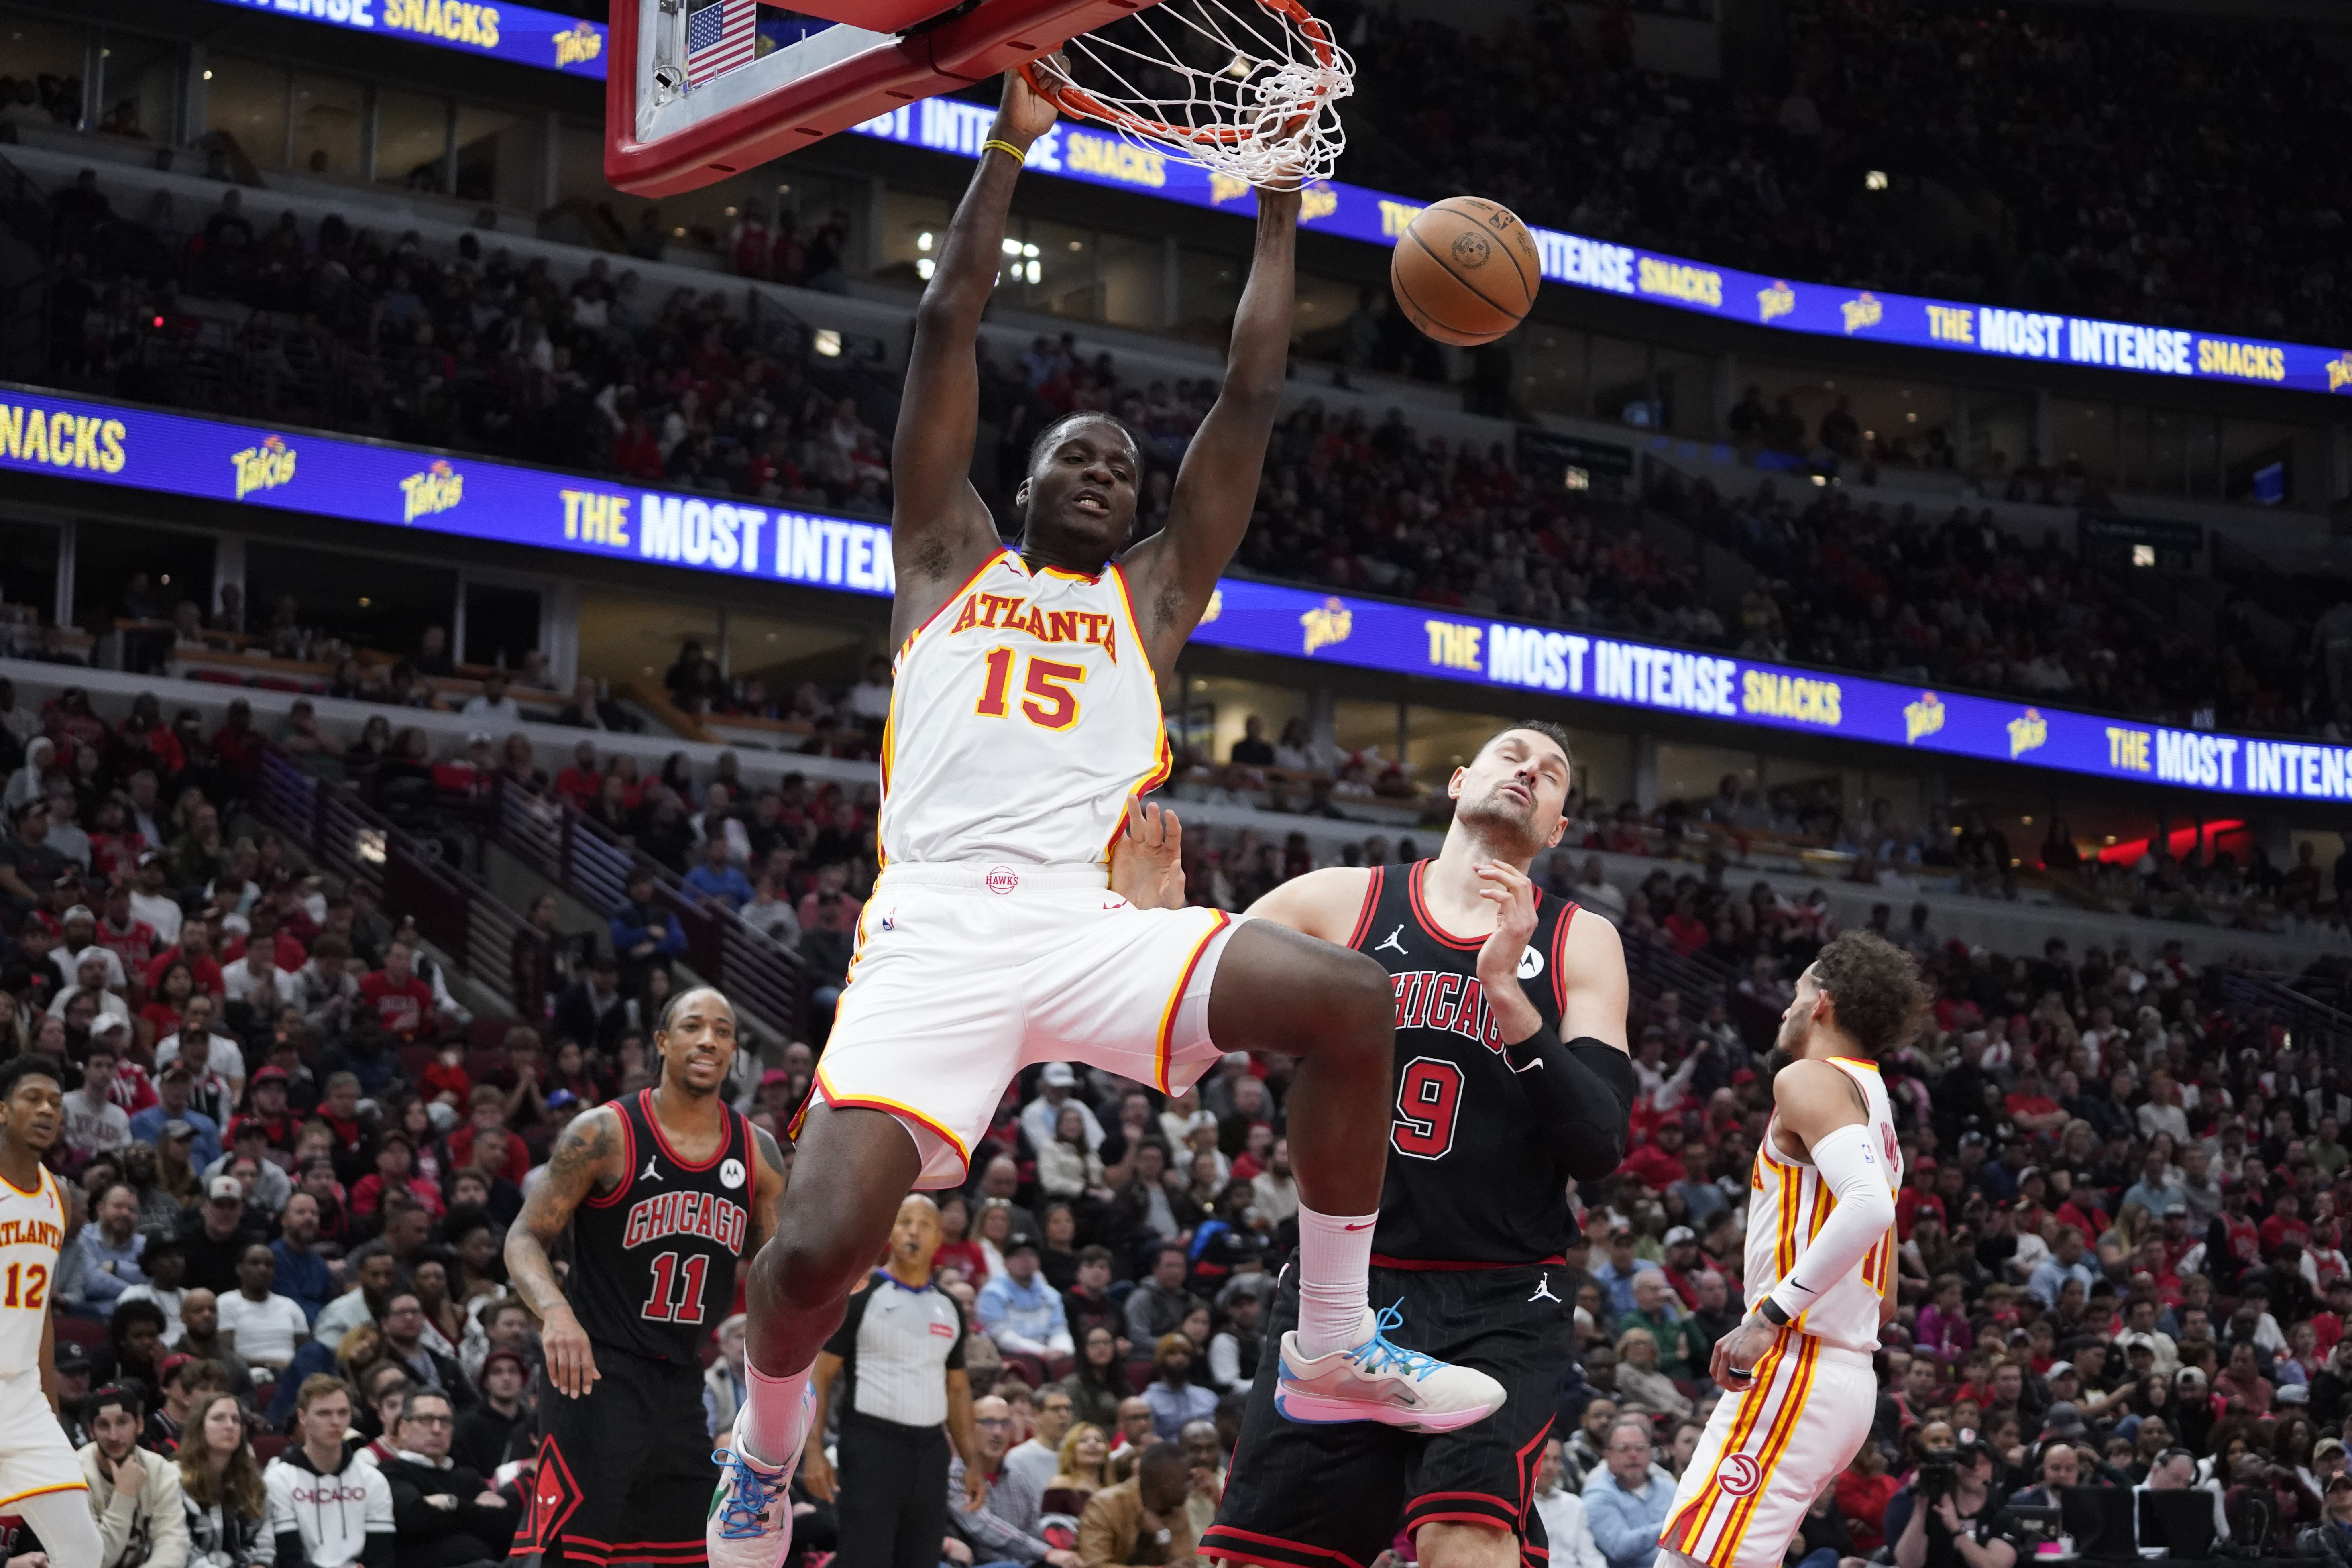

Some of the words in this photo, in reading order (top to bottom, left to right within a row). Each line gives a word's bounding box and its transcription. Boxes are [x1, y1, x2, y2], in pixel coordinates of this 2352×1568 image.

[1067, 132, 1167, 189] SNACKS
[1638, 257, 1723, 308] SNACKS
[1927, 305, 1974, 344] THE
[1979, 307, 2064, 359] MOST
[2069, 318, 2193, 375] INTENSE
[2198, 338, 2286, 381] SNACKS
[0, 406, 126, 473] NACKS
[560, 489, 631, 547] THE
[641, 493, 767, 572] MOST
[776, 513, 896, 593] INTEN
[949, 591, 1117, 668] ATLANTA
[974, 645, 1087, 733] 15
[1425, 620, 1482, 672] THE
[1488, 623, 1589, 693] MOST
[1594, 640, 1737, 716] INTENSE
[1743, 669, 1842, 726] SNACKS
[2106, 726, 2152, 773] THE
[2156, 729, 2238, 789] MOST
[986, 875, 1018, 886] HAWKS
[1390, 1055, 1465, 1161] 9
[622, 1191, 747, 1257] CHICAGO
[4, 1262, 47, 1310] 12
[641, 1251, 710, 1325] 11
